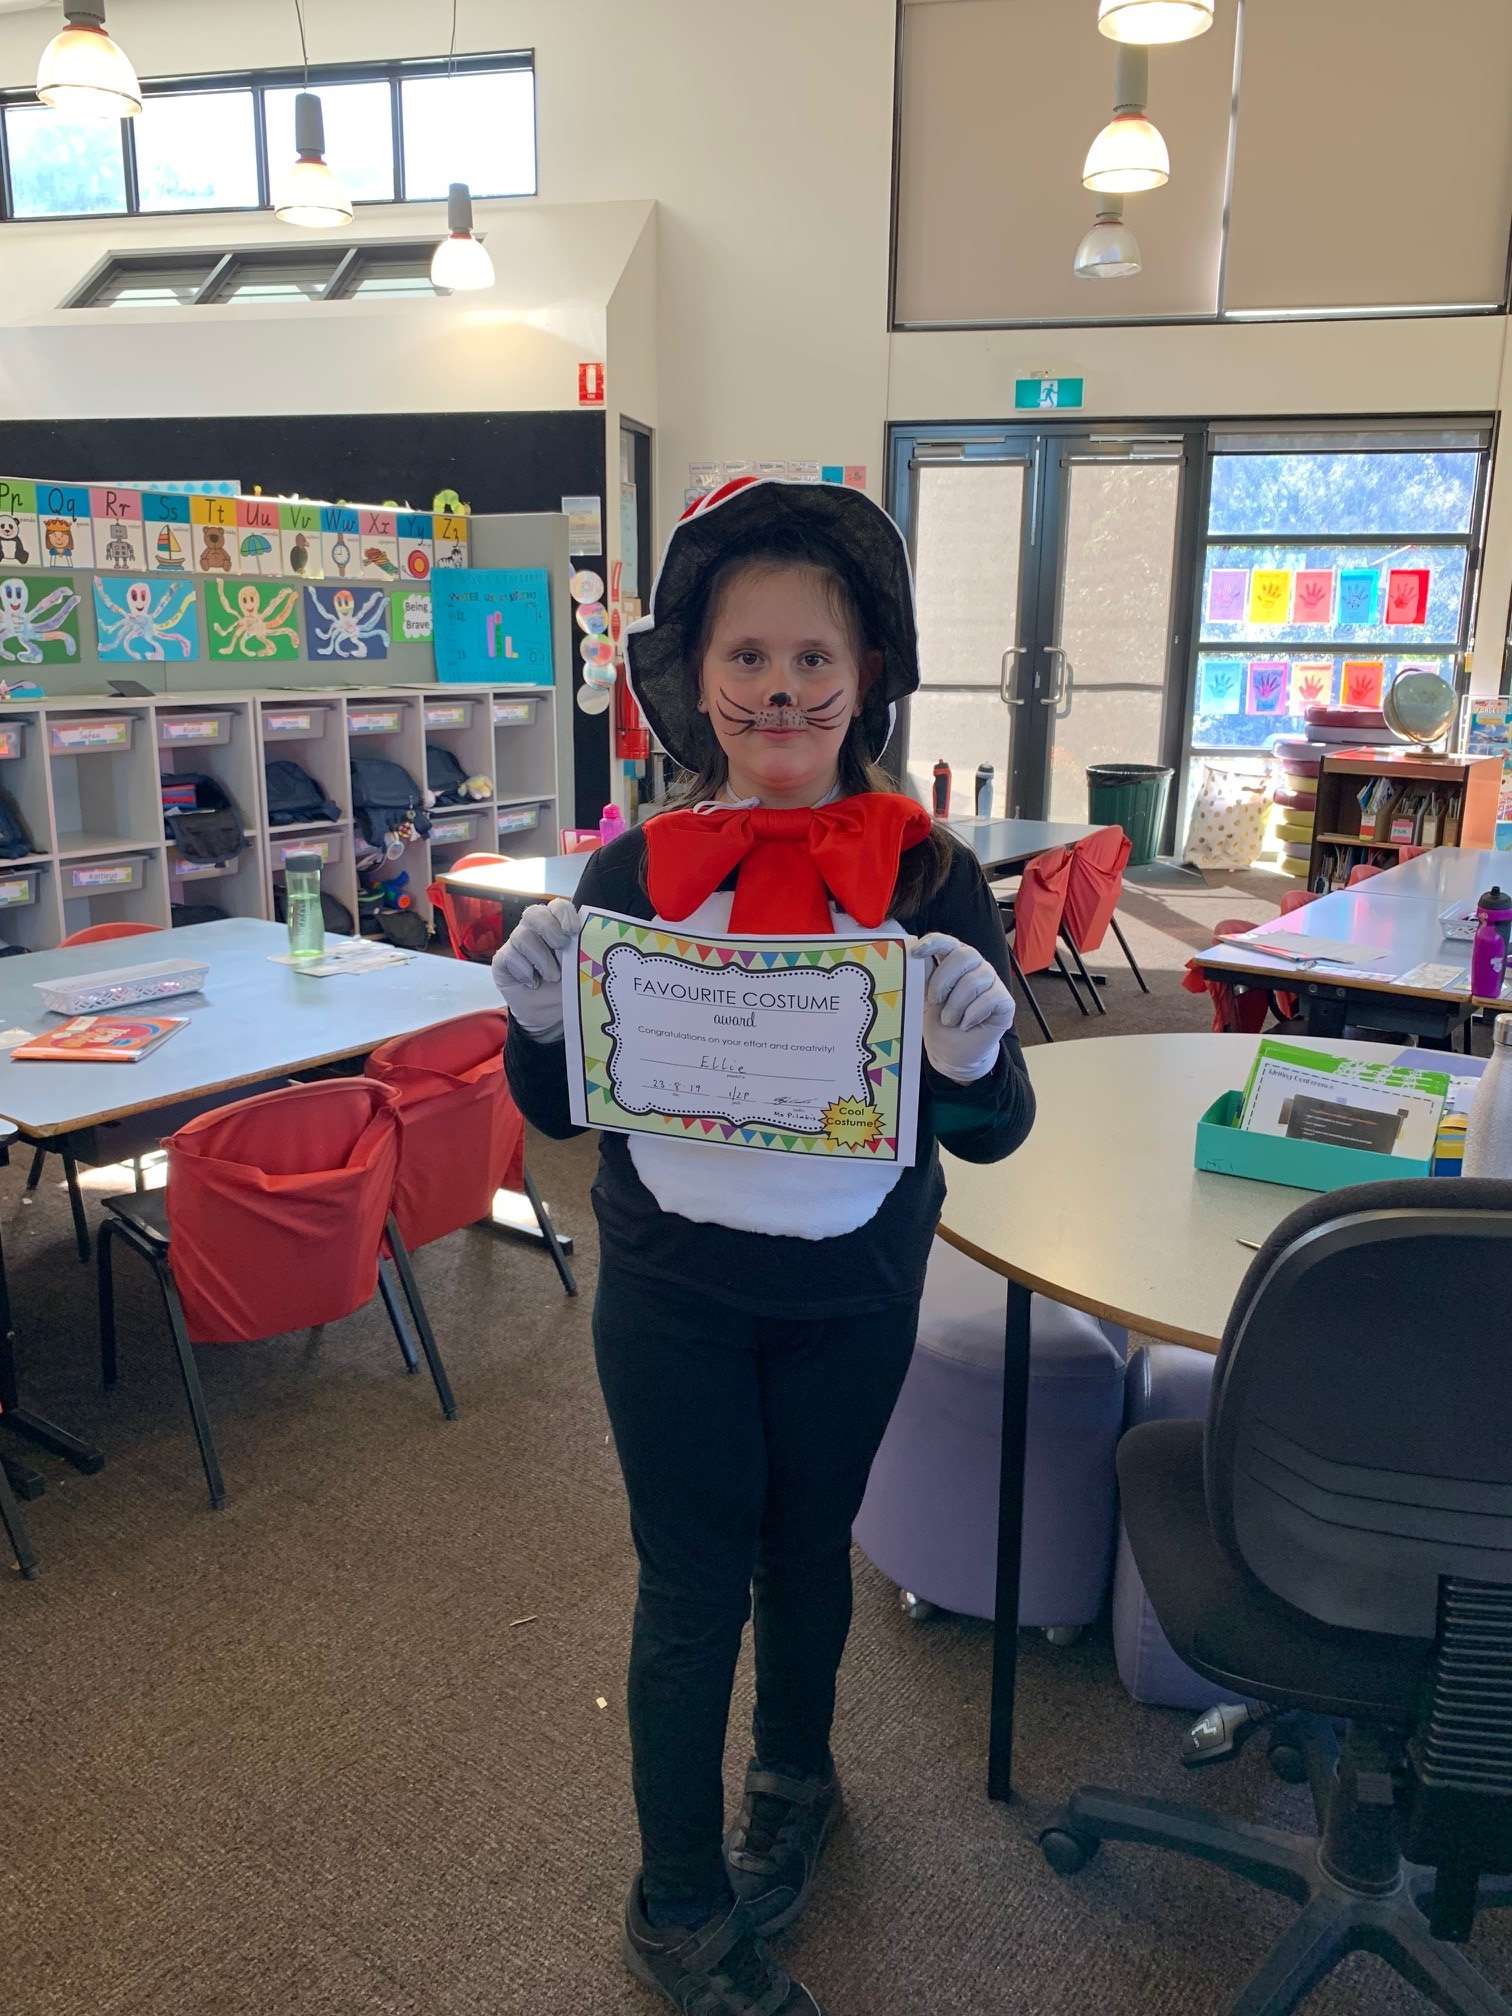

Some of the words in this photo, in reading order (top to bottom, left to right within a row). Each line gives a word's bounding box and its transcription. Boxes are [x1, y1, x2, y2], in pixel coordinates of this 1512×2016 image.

[48, 487, 78, 522] Qq
[105, 490, 132, 517] Rr
[158, 495, 179, 521] Ss
[204, 498, 225, 524] Tt
[245, 503, 271, 526] Uu
[290, 505, 312, 529] Vv
[325, 508, 357, 532] Ww
[368, 512, 390, 535] Xx
[407, 516, 425, 546] Yy
[442, 518, 461, 547] Zz
[405, 602, 429, 613] Being
[405, 620, 430, 630] Brave
[633, 977, 737, 1005] FAVOURITE
[742, 992, 841, 1011] COSTUME
[713, 1011, 757, 1028] award
[637, 1025, 707, 1043] Congratulations
[721, 1039, 742, 1048] your
[743, 1040, 768, 1049] effort
[769, 1043, 789, 1051] and
[790, 1044, 835, 1054] creativity!
[839, 1106, 865, 1116] Cool
